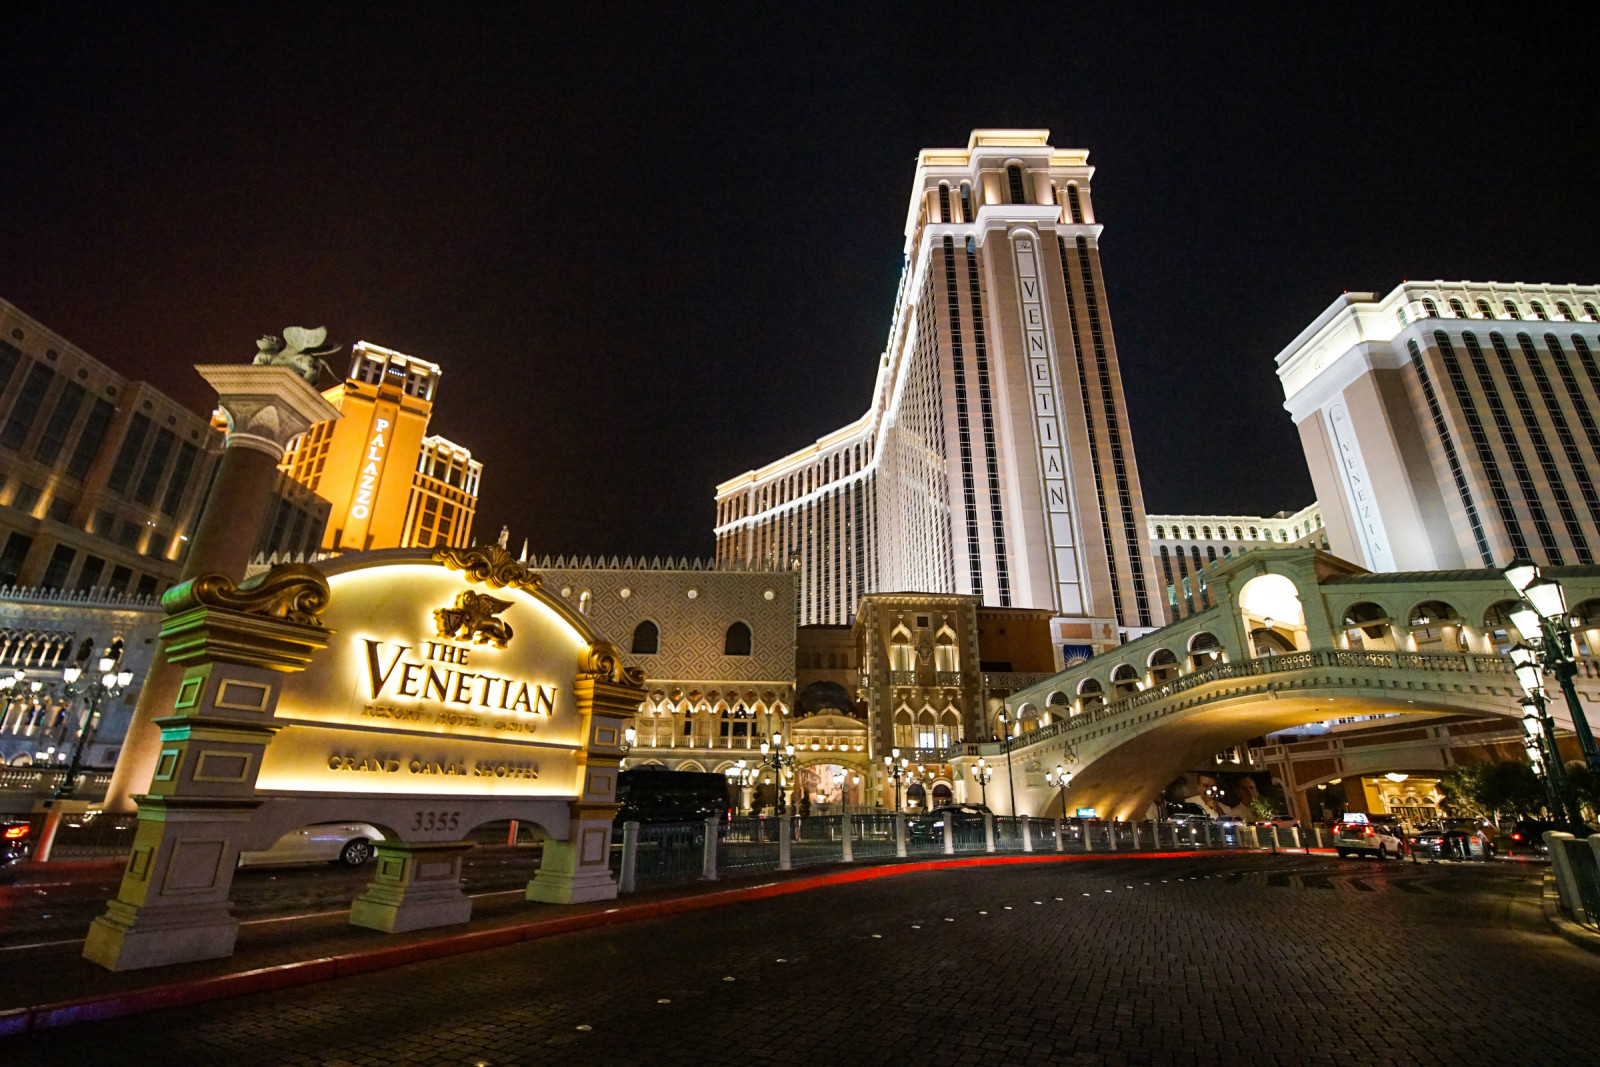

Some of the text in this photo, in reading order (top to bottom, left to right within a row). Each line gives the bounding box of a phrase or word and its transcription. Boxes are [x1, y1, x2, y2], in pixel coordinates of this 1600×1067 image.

[1023, 281, 1064, 505] VENETIAN
[352, 418, 389, 519] PALAZZO
[1342, 442, 1382, 553] VENEZIA
[424, 641, 471, 666] THE
[326, 756, 401, 773] GRAND
[411, 811, 461, 832] 3355
